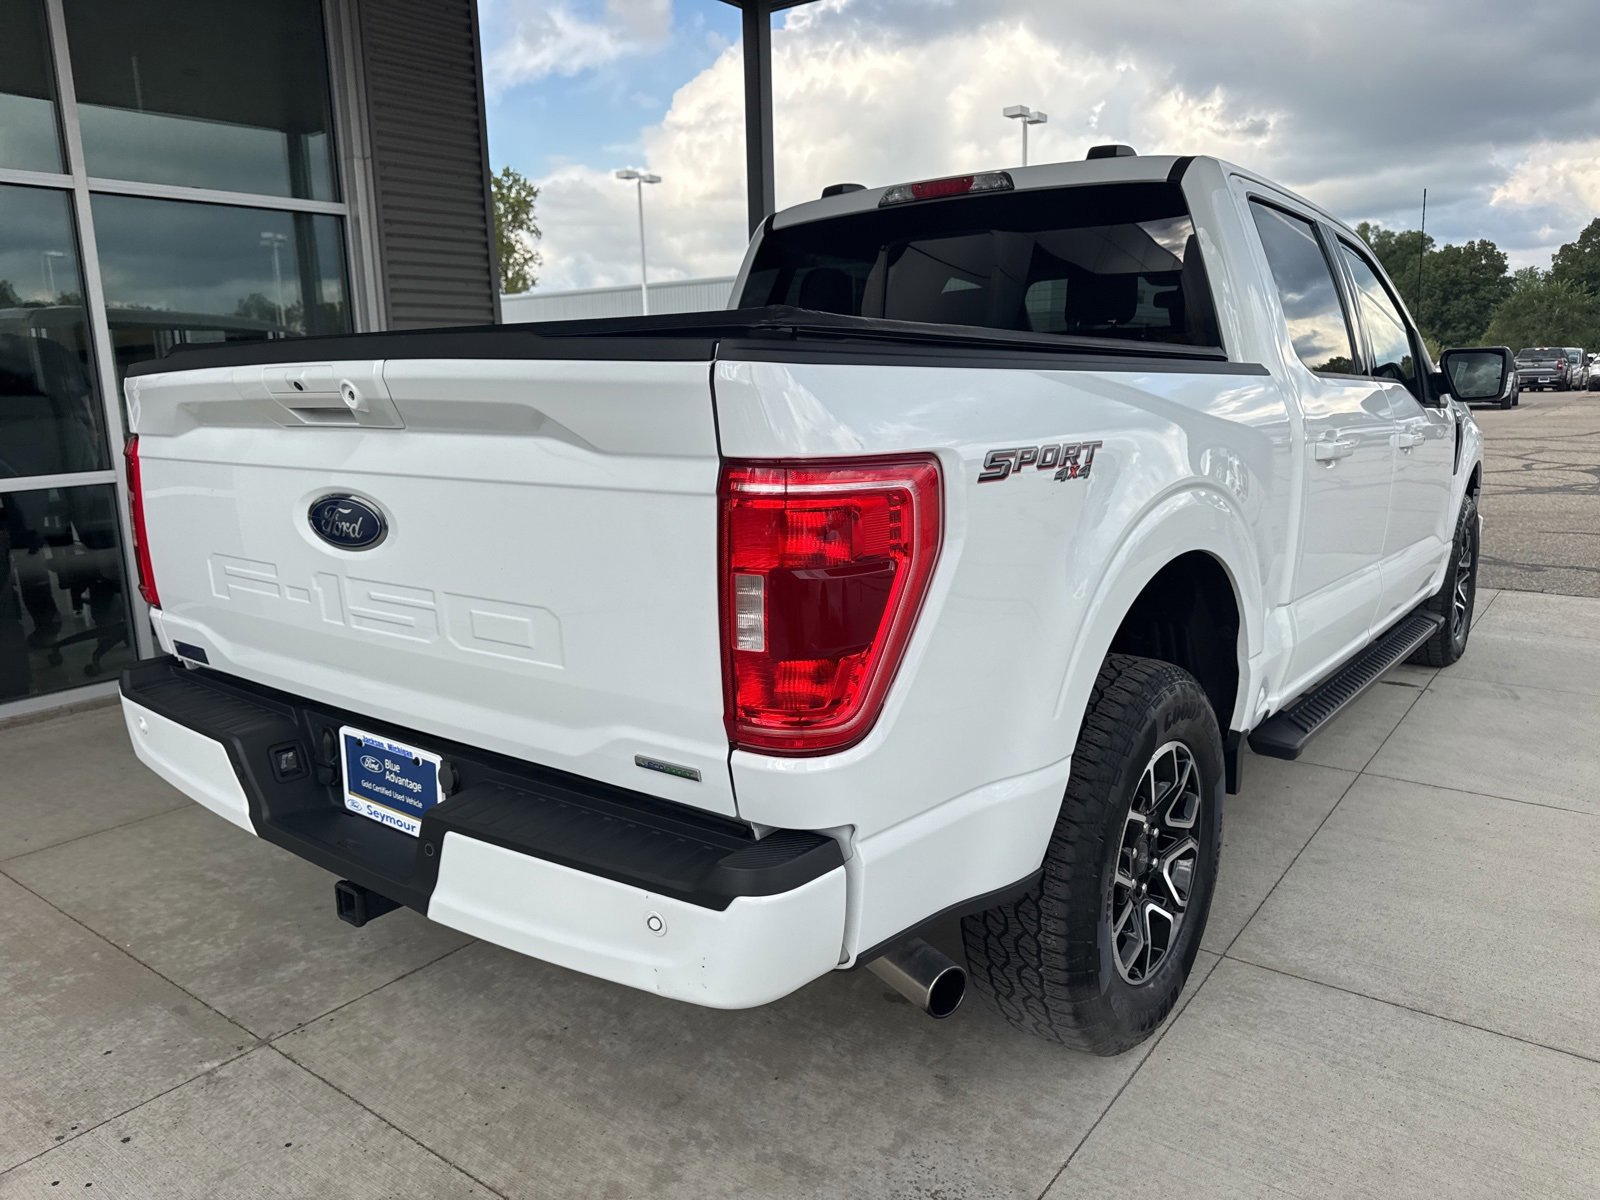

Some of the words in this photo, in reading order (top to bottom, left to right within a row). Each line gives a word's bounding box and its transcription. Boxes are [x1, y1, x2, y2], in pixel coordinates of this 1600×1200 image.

[977, 440, 1103, 483] SPORT
[320, 503, 364, 540] Ford
[207, 552, 564, 669] F-150
[384, 758, 401, 773] Blue
[360, 779, 373, 790] Gold
[372, 783, 392, 797] Certified
[392, 790, 406, 802] Used
[405, 794, 423, 809] Vehicle
[385, 770, 422, 792] Advantage
[366, 805, 416, 832] Seymour
